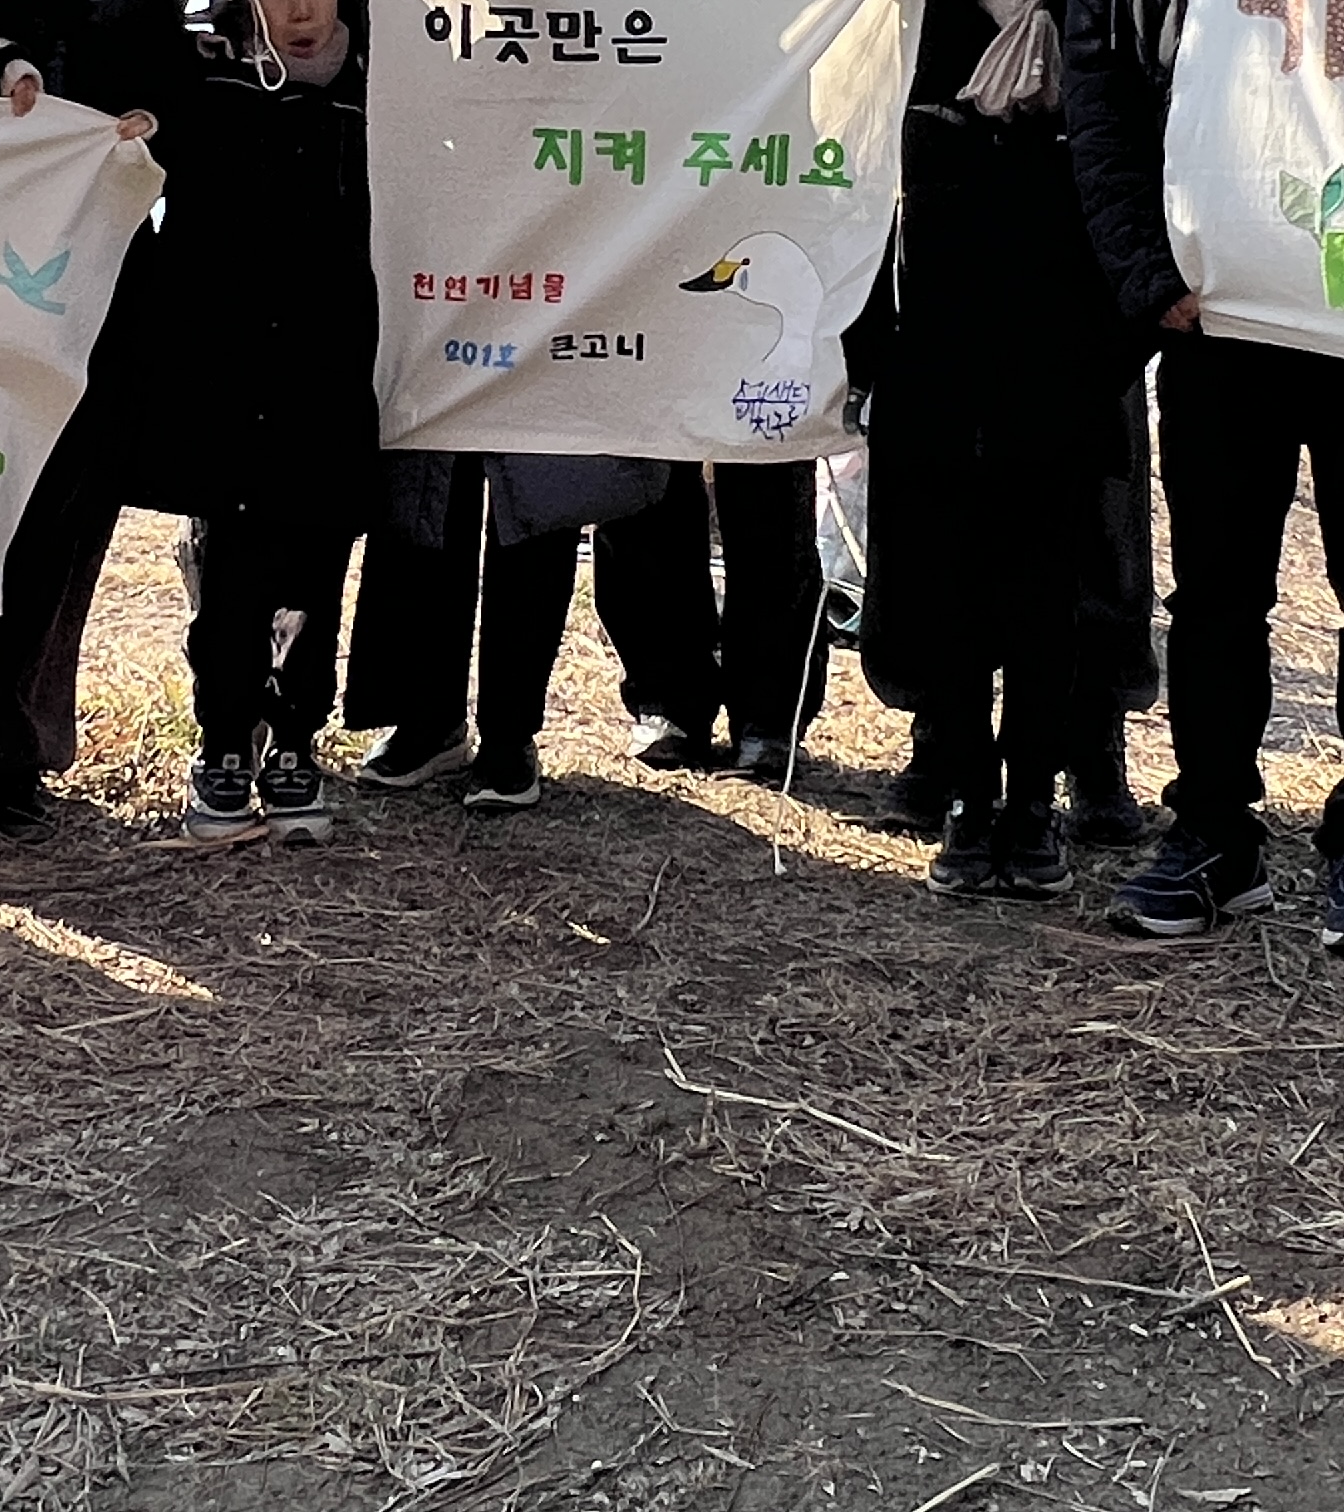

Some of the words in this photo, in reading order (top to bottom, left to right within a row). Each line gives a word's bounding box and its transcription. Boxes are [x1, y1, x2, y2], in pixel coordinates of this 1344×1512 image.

[423, 2, 669, 65] 이곳만은
[533, 127, 647, 186] 지켜
[683, 131, 853, 188] 주세요
[412, 272, 565, 304] 천연기념물
[444, 338, 519, 369] 201호
[548, 332, 645, 363] 큰고니
